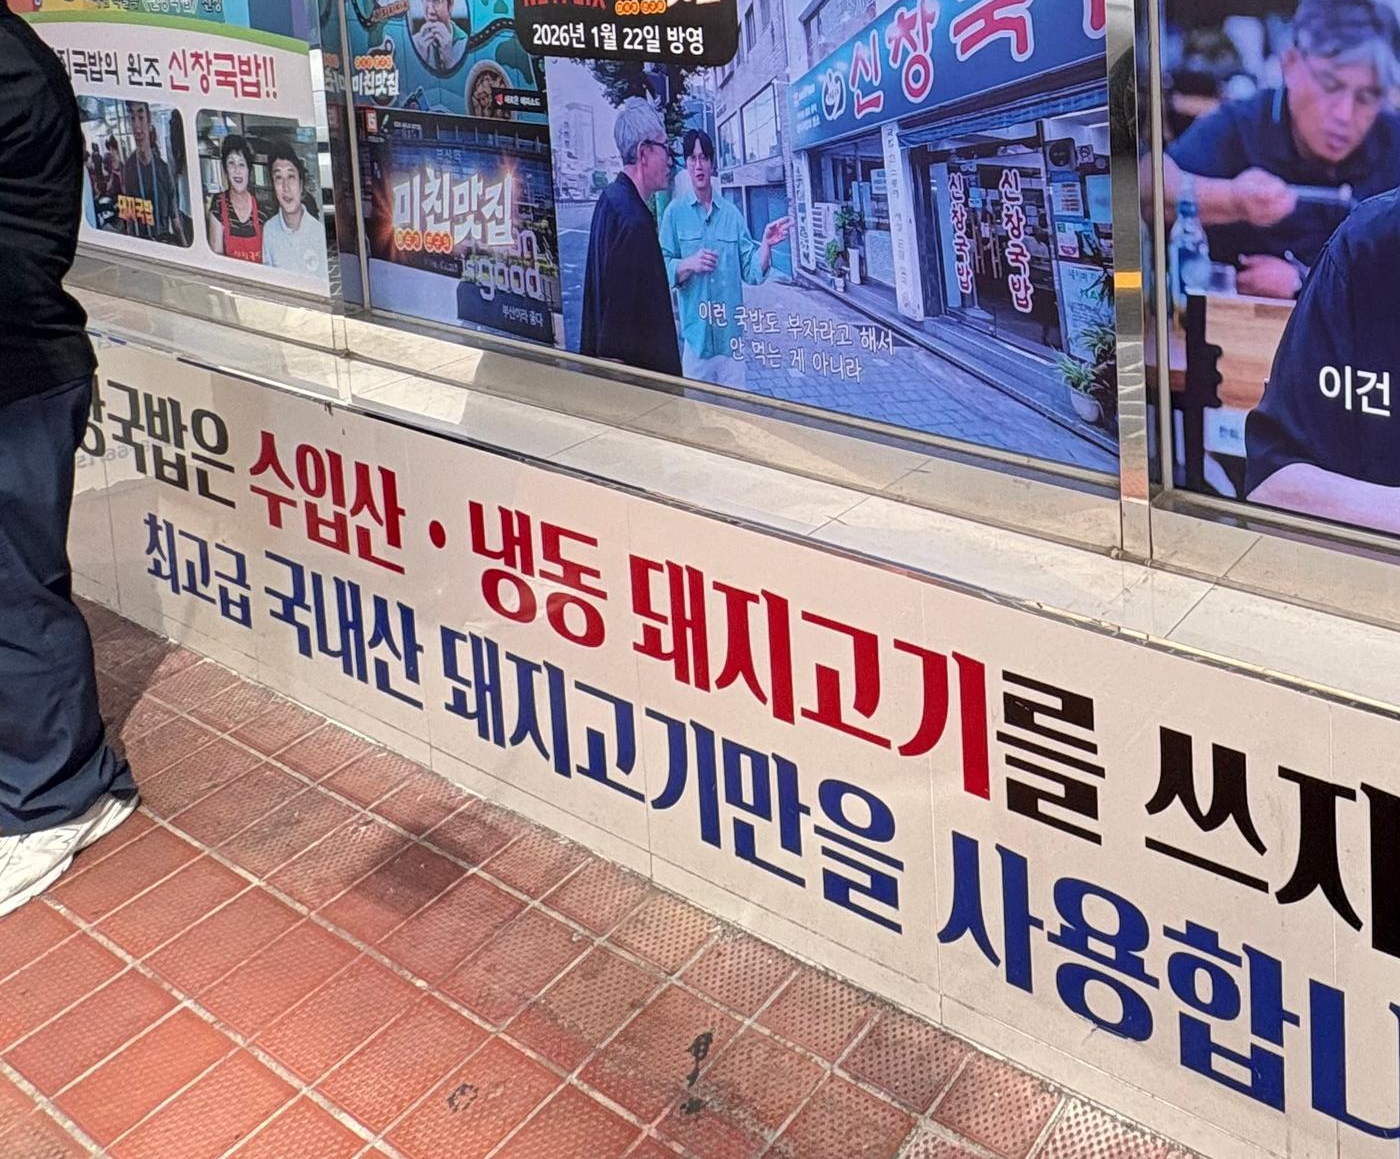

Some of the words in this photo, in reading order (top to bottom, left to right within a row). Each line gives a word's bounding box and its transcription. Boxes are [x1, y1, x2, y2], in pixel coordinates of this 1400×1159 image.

[532, 22, 586, 50] 2026년
[591, 24, 619, 51] 1월
[623, 26, 660, 54] 22일
[667, 26, 705, 56] 방영
[53, 47, 120, 86] 지국밥의
[127, 52, 163, 88] 원조
[168, 50, 278, 100] 신창국밥!!
[351, 69, 400, 97] 미친맛집
[393, 166, 516, 246] 미친맛집
[947, 170, 974, 296] 신창국밥
[998, 167, 1033, 314] 신창국밥
[479, 256, 545, 301] good
[699, 299, 728, 327] 이런
[734, 305, 780, 337] 국밥도
[787, 313, 853, 347] 부자라고
[860, 324, 894, 356] 해서
[729, 338, 747, 361] 안
[751, 340, 782, 368] 먹는
[790, 348, 806, 372] 게
[812, 352, 864, 383] 아니라
[1317, 364, 1392, 417] 이건
[249, 430, 405, 576] 수입산
[469, 499, 608, 649] 냉동
[631, 552, 1106, 845] 돼지고기를
[143, 510, 253, 630] 최고급
[264, 549, 425, 711] 국내산
[440, 622, 905, 934] 돼지고기만을
